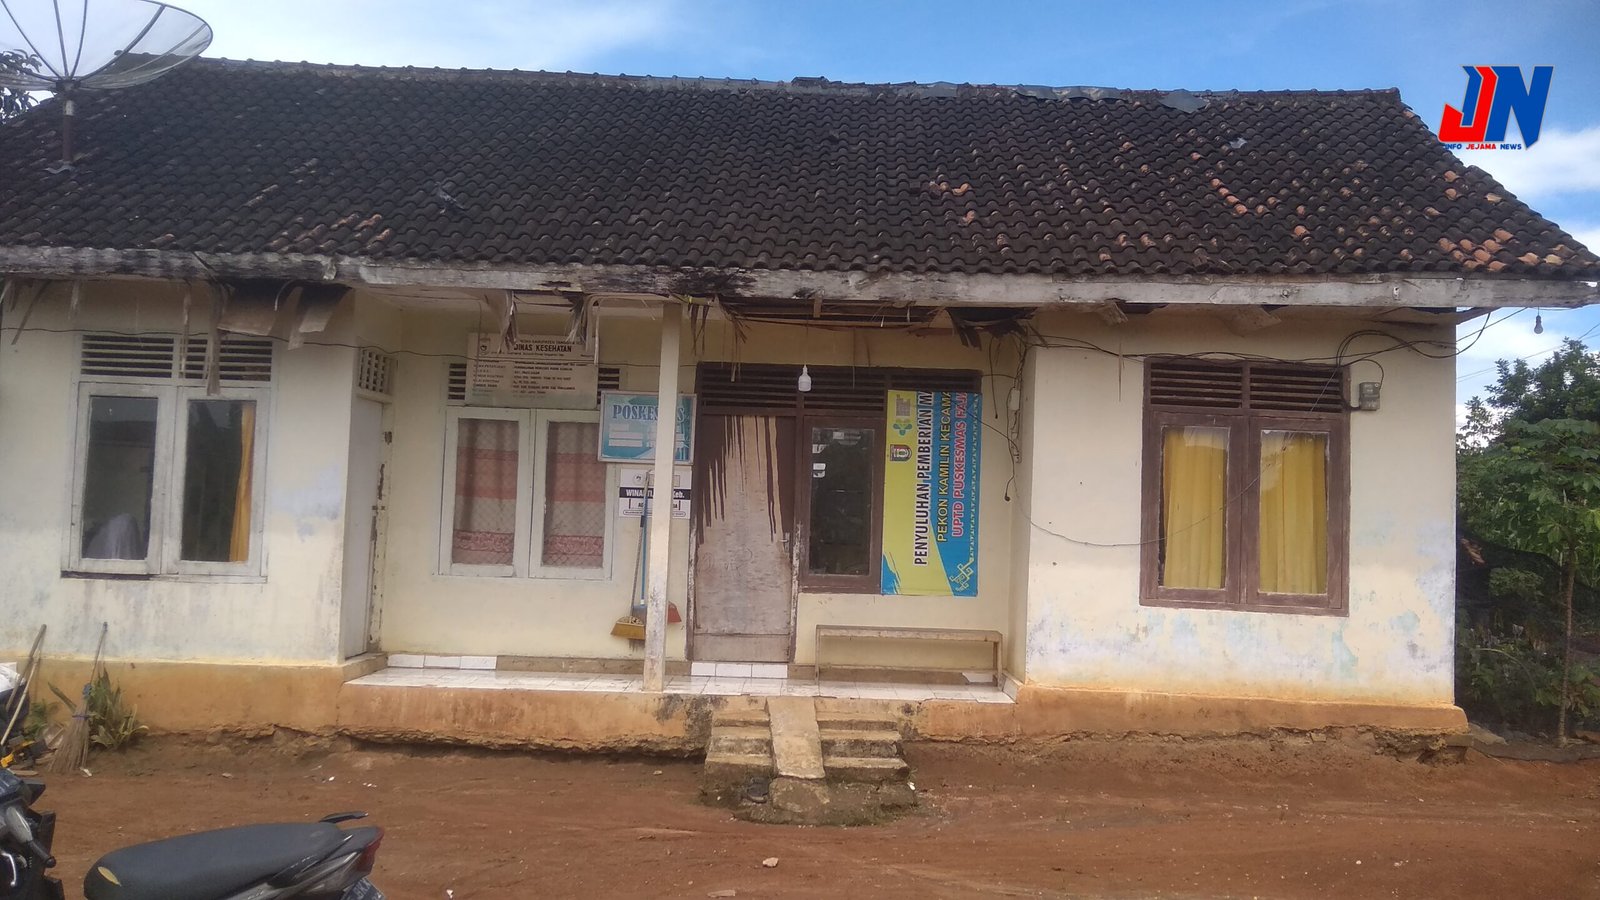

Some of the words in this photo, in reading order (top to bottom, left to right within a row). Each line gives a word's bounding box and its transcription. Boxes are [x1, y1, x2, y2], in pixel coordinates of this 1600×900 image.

[536, 344, 572, 353] KESEHATAN
[612, 404, 685, 422] POSKESS
[916, 410, 932, 479] PEMBERIAN
[953, 421, 965, 498] PUSKESMAS
[938, 445, 951, 494] KAMILIN
[914, 483, 930, 565] PENYULUHAN
[937, 498, 949, 542] PEKON
[952, 502, 964, 536] UPTD
